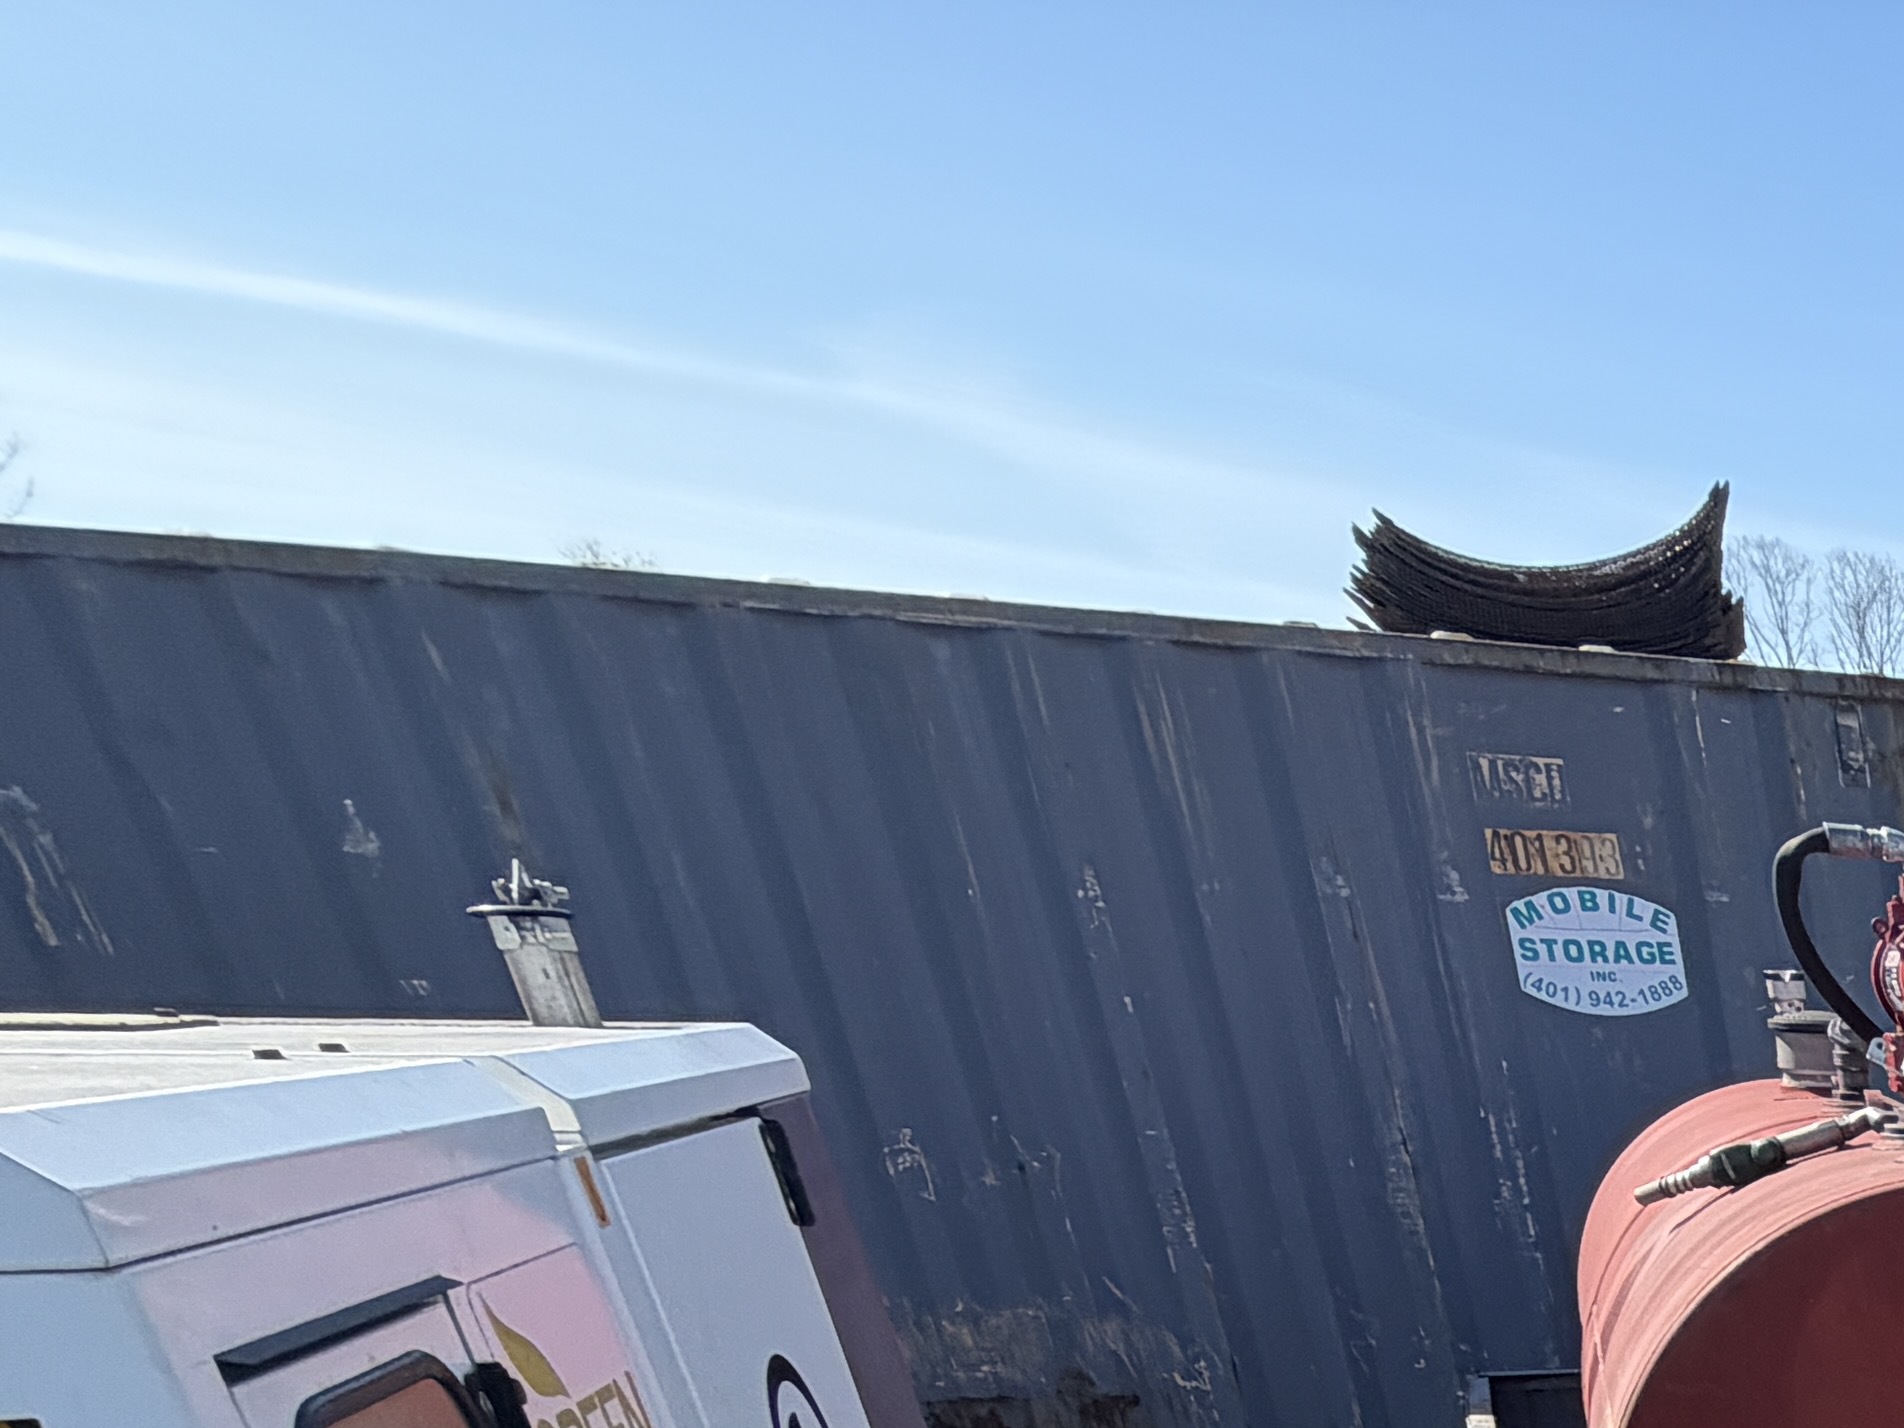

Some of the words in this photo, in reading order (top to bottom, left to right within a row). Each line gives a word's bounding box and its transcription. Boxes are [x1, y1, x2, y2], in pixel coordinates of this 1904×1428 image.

[1488, 829, 1622, 877] 401393
[1510, 889, 1671, 934] MOBILE
[1517, 937, 1676, 965] STORAGE
[1523, 972, 1581, 1006] (401)
[1589, 974, 1684, 1009] 942-1888
[1590, 970, 1623, 983] INC.
